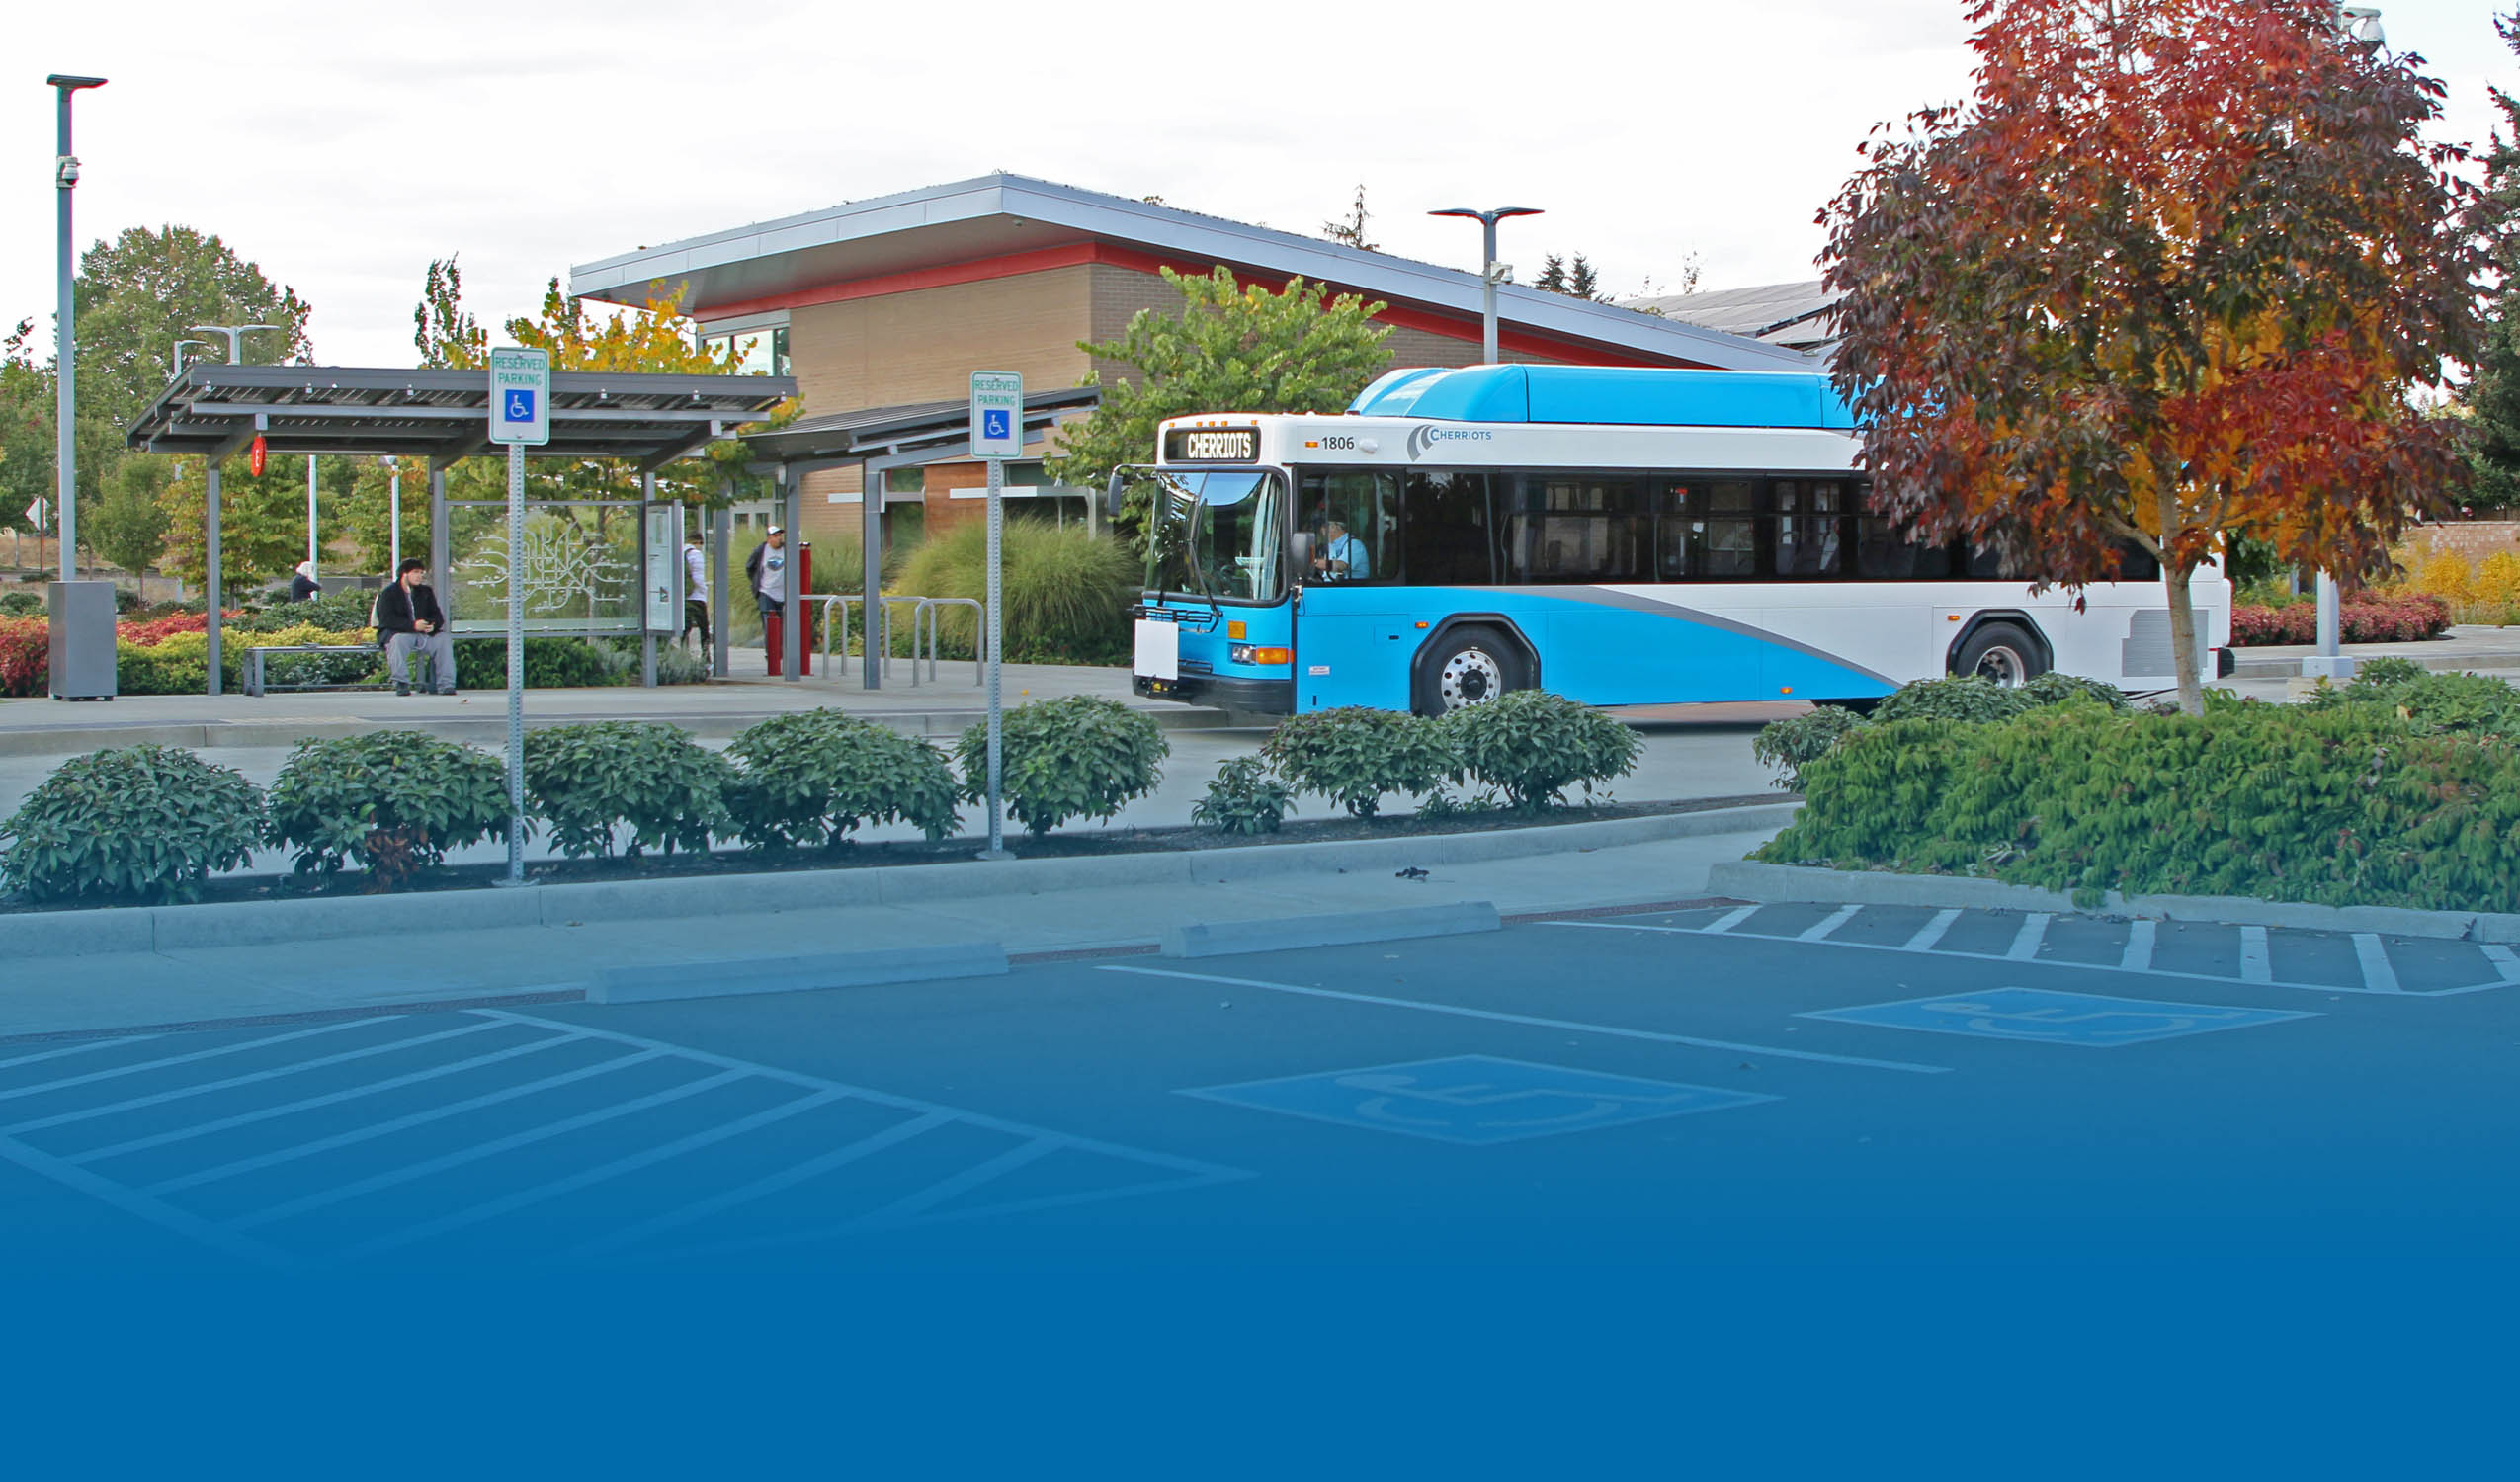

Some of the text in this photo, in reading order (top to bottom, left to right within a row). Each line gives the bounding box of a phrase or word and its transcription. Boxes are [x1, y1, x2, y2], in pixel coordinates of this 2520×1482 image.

[495, 357, 546, 370] RESERVED
[498, 373, 542, 386] PARKING
[973, 380, 1020, 392] RESERVED
[978, 395, 1015, 407] PARKING
[1430, 429, 1492, 441] CHERRIOTS
[1188, 432, 1251, 458] CHERRIOTS
[1321, 436, 1355, 450] 1806
